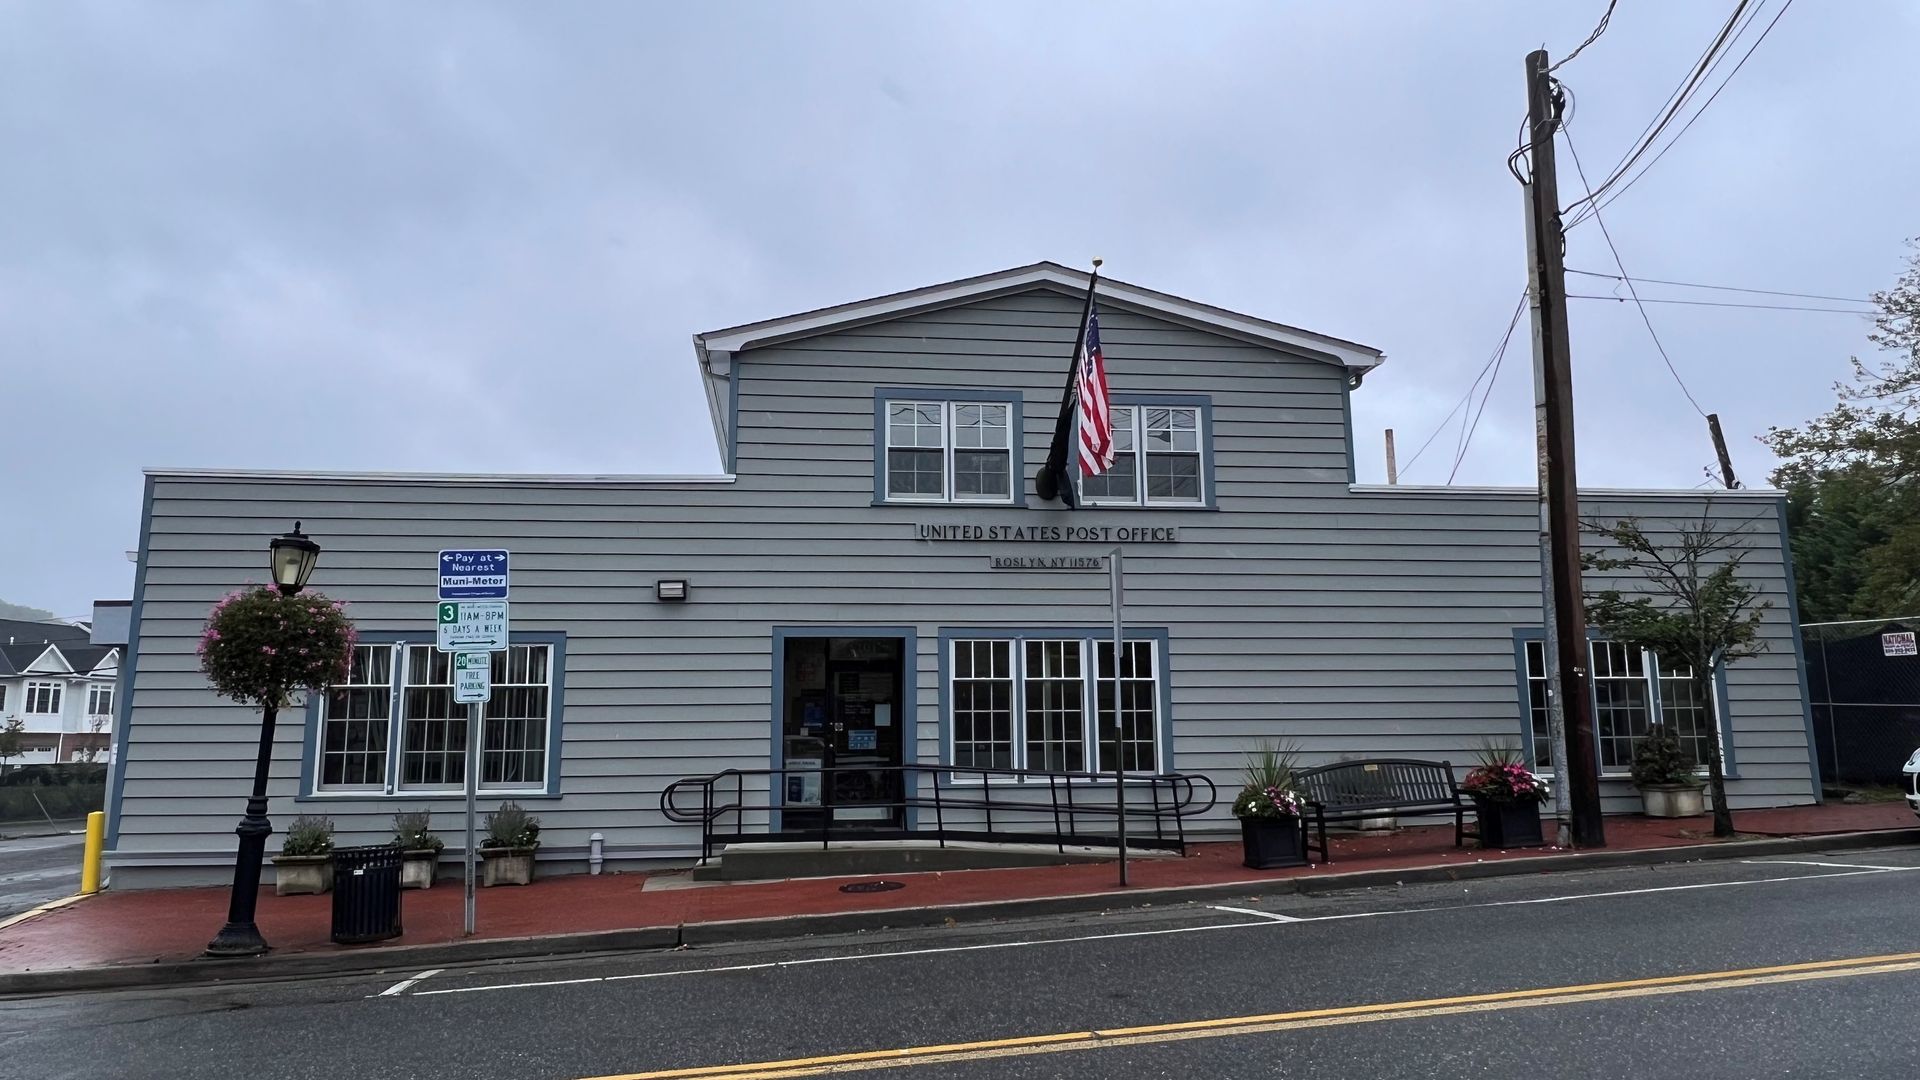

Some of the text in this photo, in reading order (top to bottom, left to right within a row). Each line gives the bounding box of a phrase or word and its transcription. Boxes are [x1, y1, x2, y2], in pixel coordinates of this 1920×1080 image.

[920, 524, 1176, 541] UNITED STATES POST OFFICE
[455, 553, 493, 563] Pay at
[1051, 557, 1067, 568] NY
[1069, 557, 1100, 568] 11576
[452, 563, 495, 572] Nearest
[442, 577, 504, 586] Muni-Meter
[443, 605, 454, 621] 3
[460, 611, 504, 621] 11AM-8PM
[452, 625, 471, 634] DAYS
[475, 625, 480, 633] A
[484, 624, 503, 633] WEEK
[1883, 633, 1914, 645] NATIONAL
[456, 656, 466, 666] 20
[465, 671, 481, 680] FREE
[460, 682, 485, 690] PARKING
